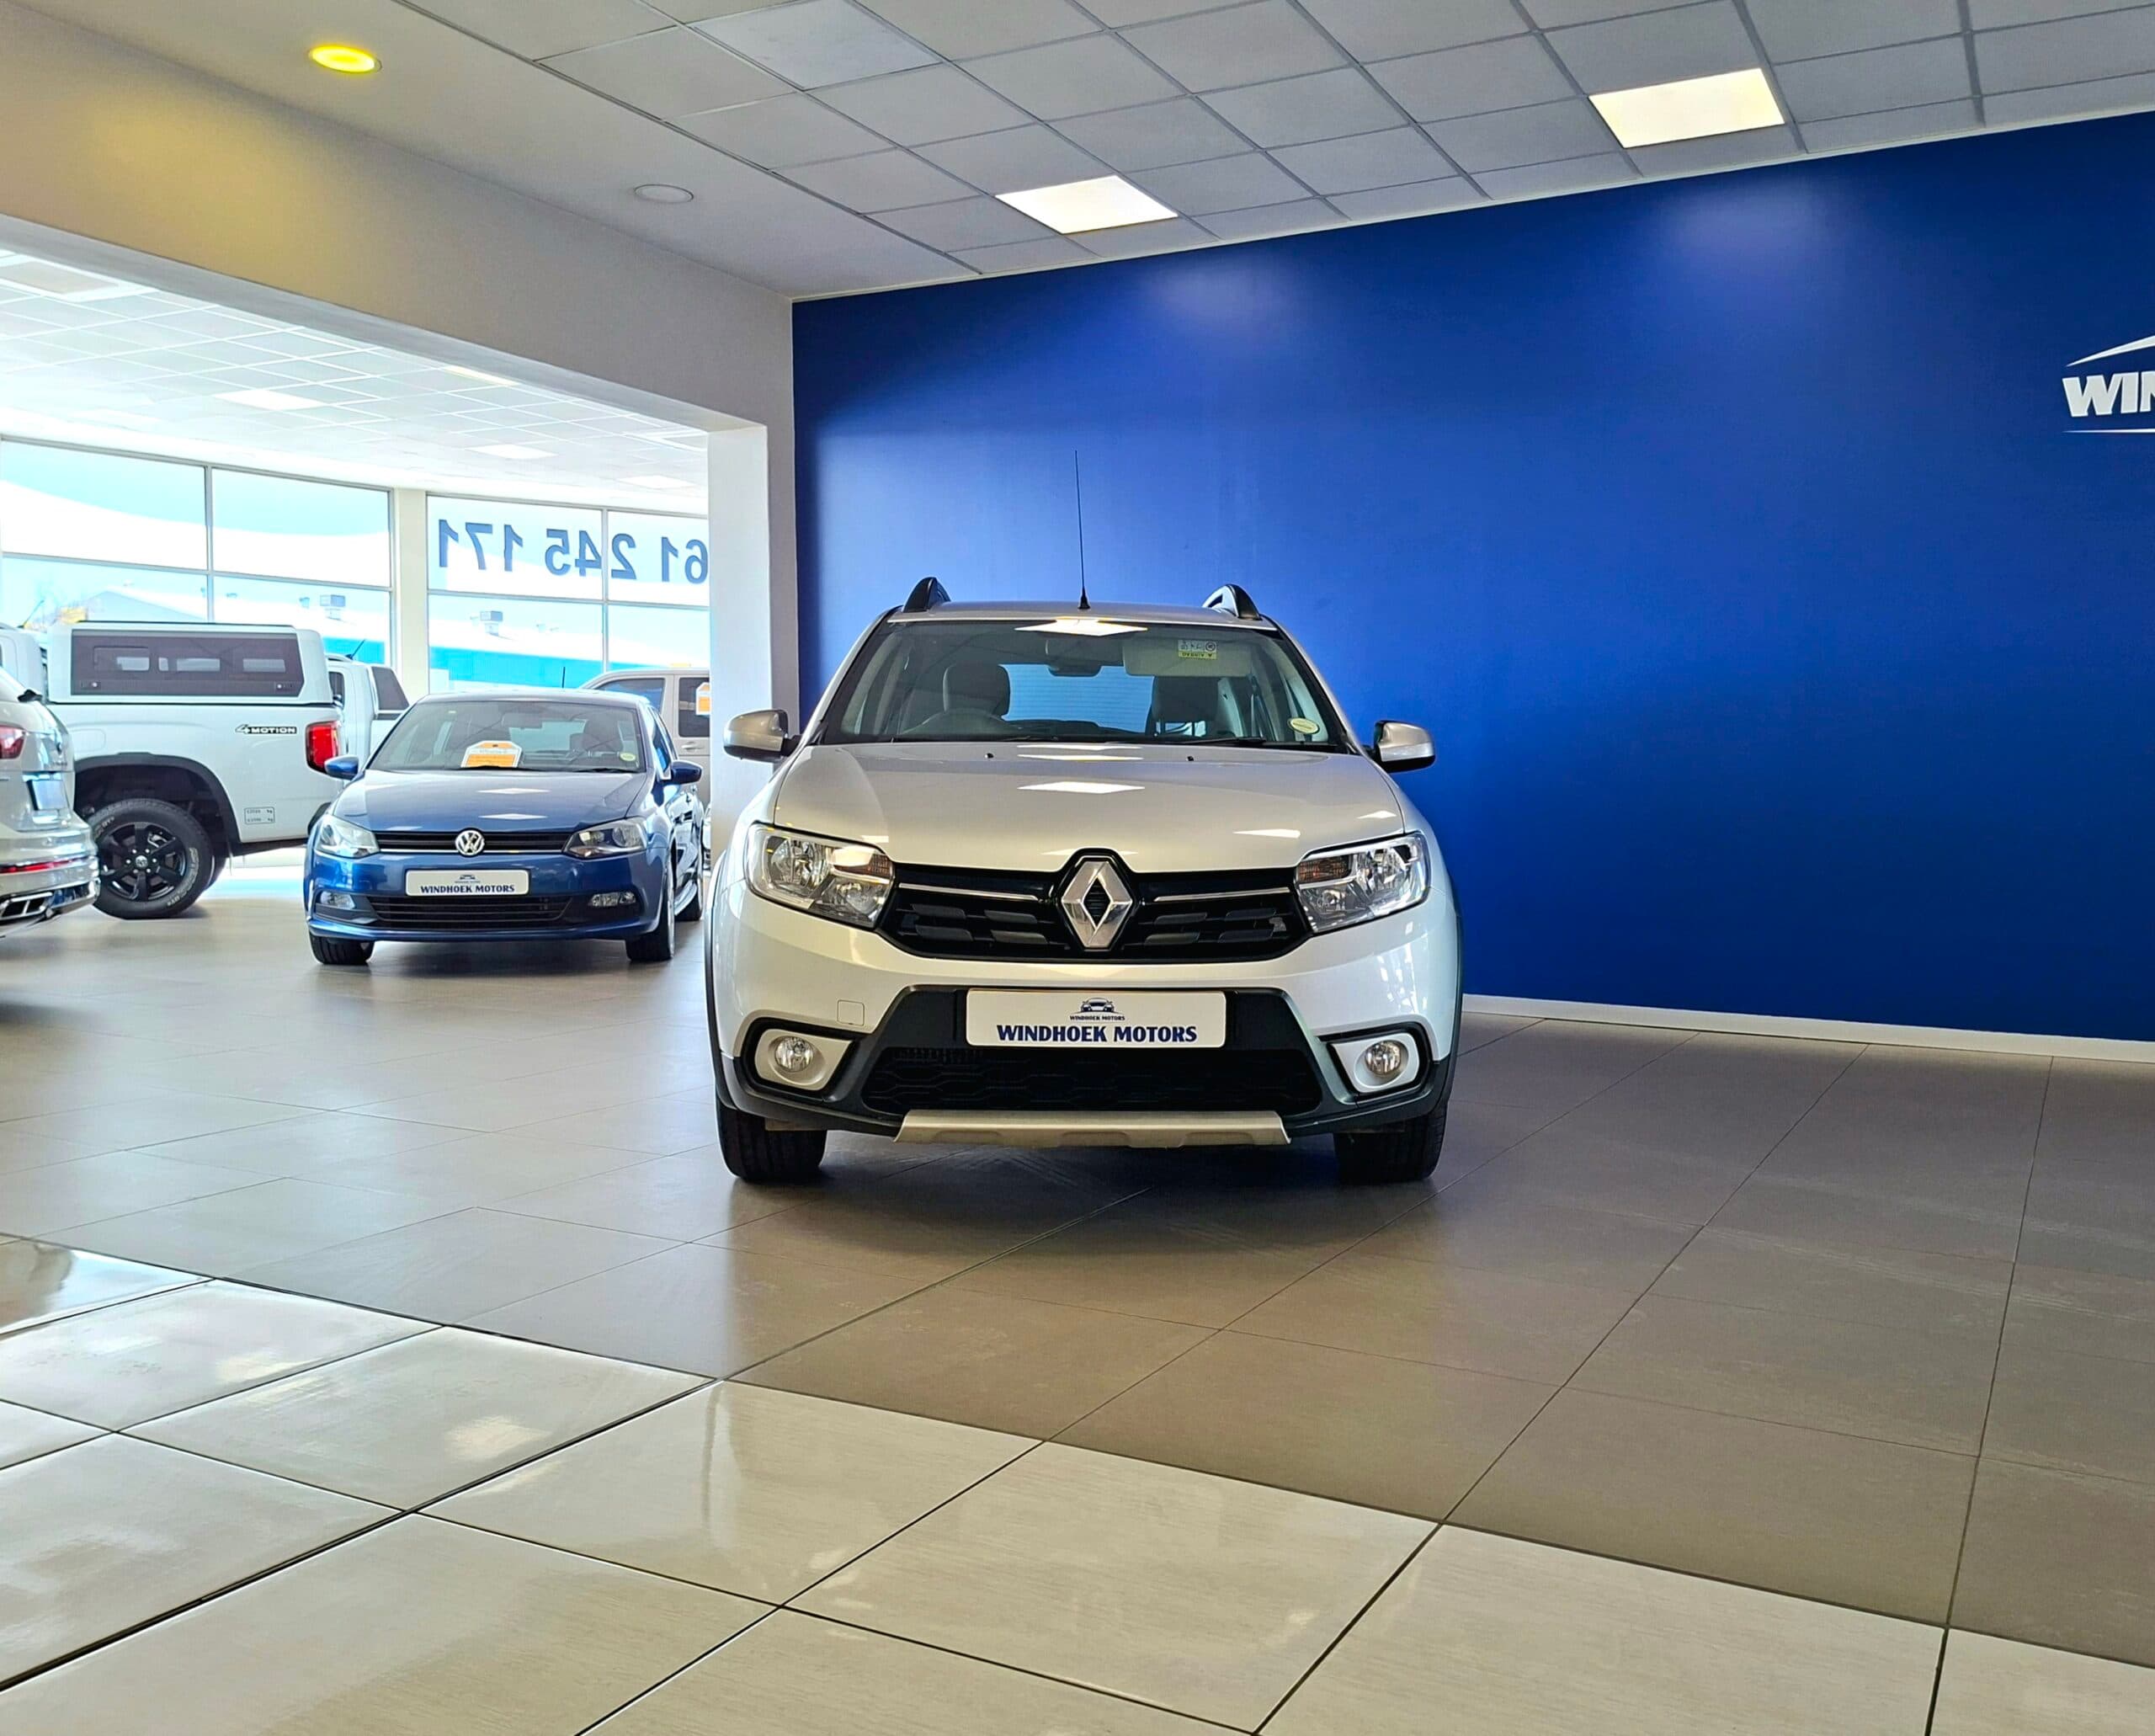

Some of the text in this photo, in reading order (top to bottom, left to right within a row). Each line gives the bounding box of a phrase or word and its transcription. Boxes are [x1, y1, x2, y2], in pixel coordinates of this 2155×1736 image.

[235, 723, 297, 735] 4MOTION
[421, 884, 515, 894] WINDHOEK MOTORS
[997, 1024, 1197, 1043] WINDHOEK MOTORS
